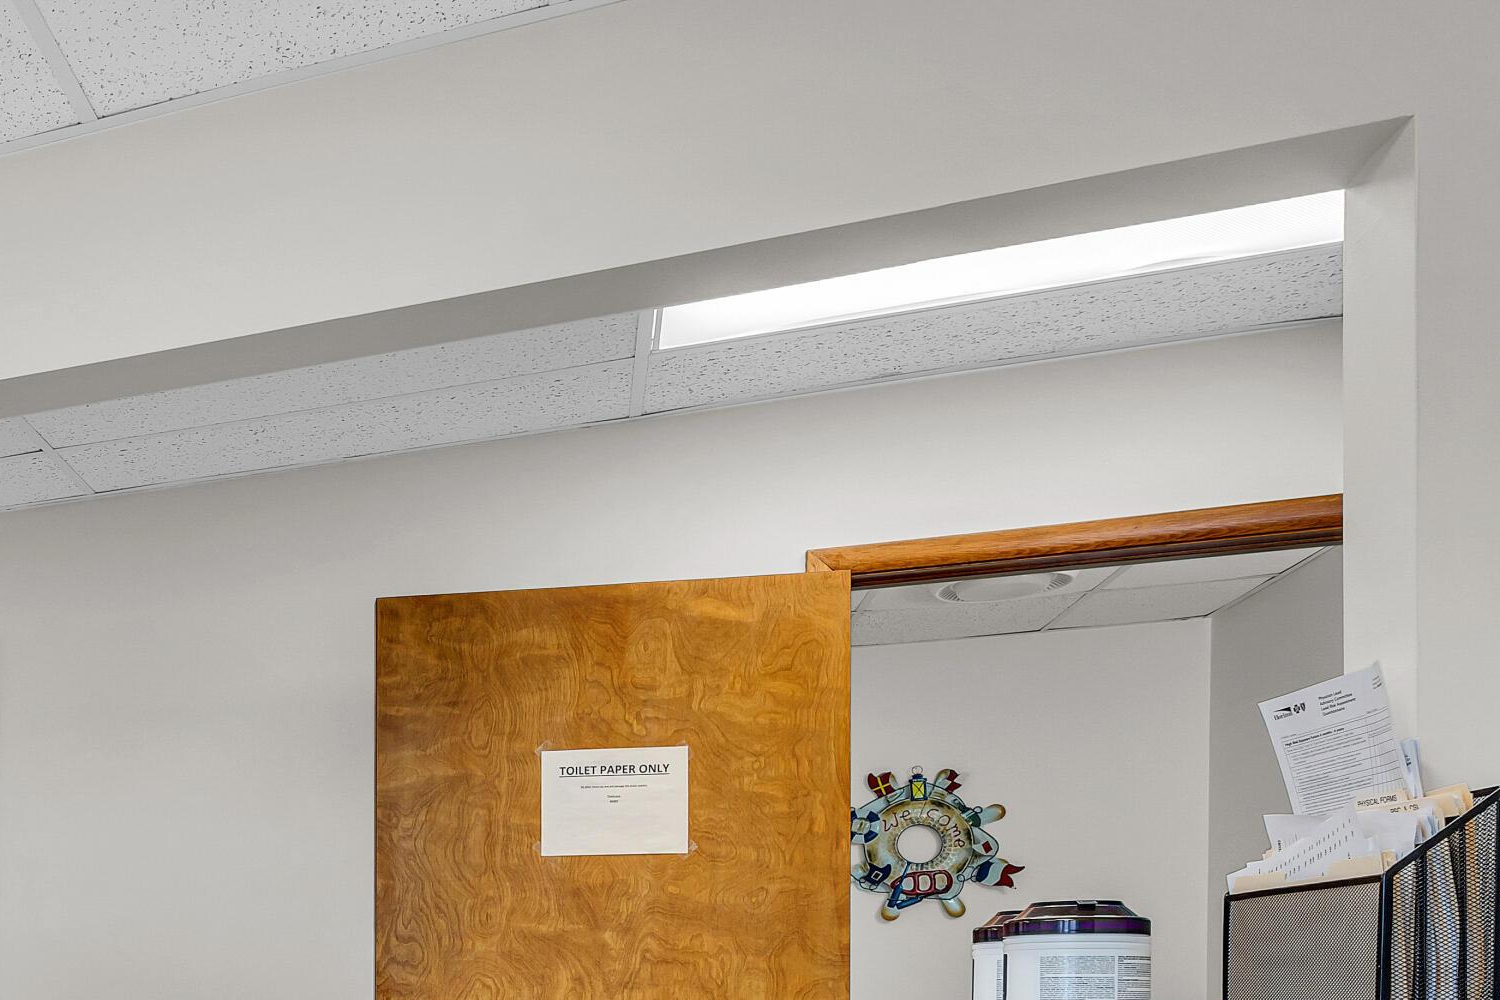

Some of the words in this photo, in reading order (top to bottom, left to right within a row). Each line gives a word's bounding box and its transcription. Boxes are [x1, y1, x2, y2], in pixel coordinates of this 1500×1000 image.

[559, 766, 597, 775] TOILET
[600, 764, 636, 774] PAPER
[639, 763, 670, 773] ONLY
[1380, 794, 1397, 803] FORMS
